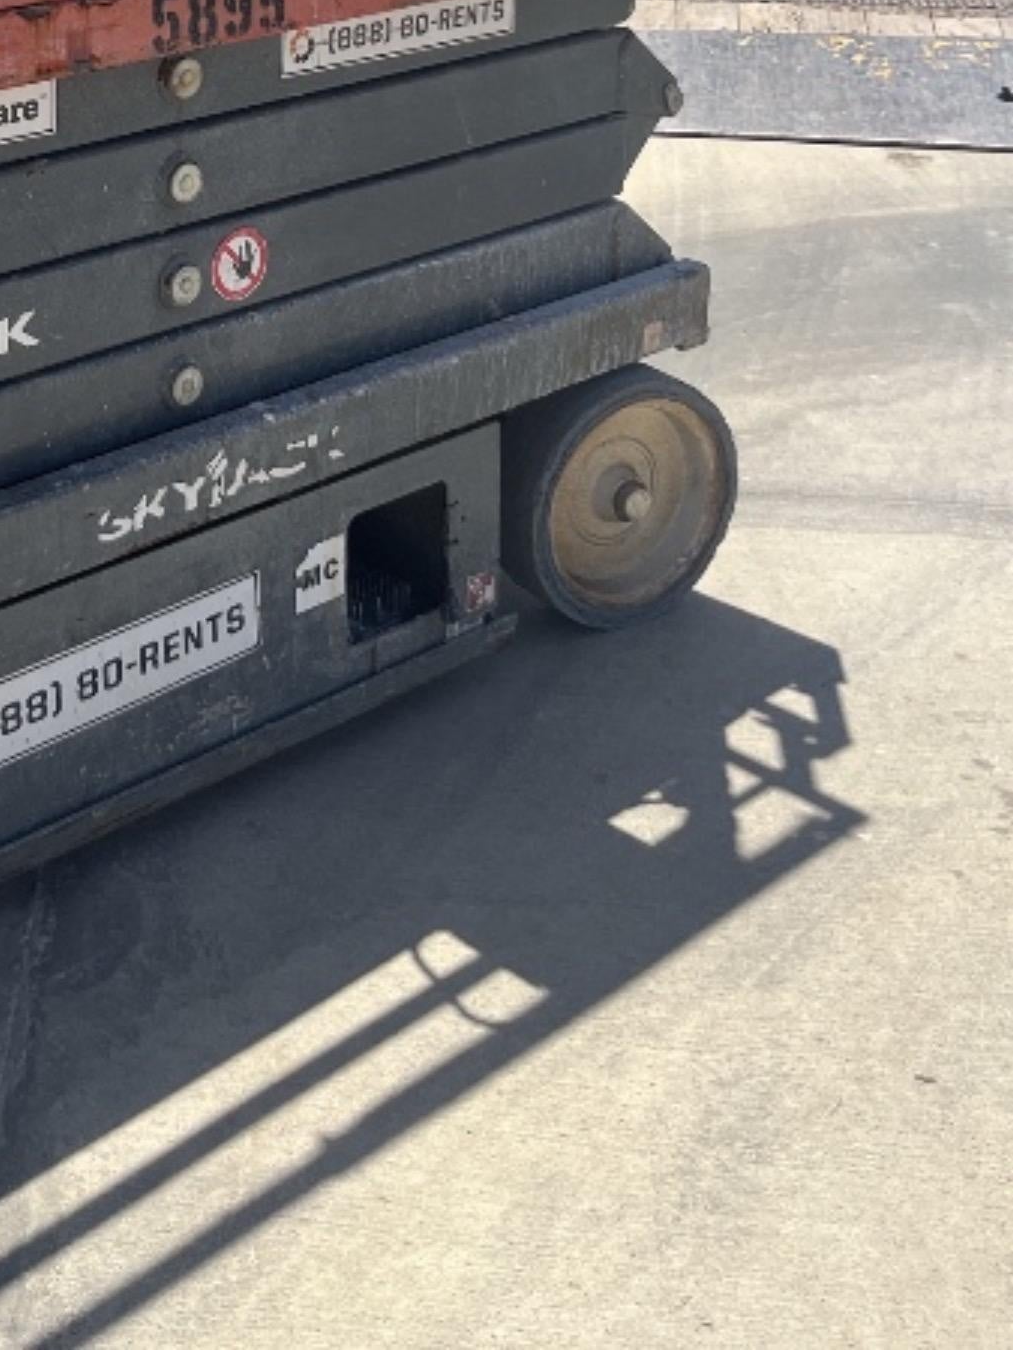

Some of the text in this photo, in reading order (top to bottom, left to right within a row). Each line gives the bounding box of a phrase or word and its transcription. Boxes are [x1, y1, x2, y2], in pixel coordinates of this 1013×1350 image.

[328, 0, 505, 54] (888) 80-RENTS
[76, 602, 247, 703] 80-RENTS
